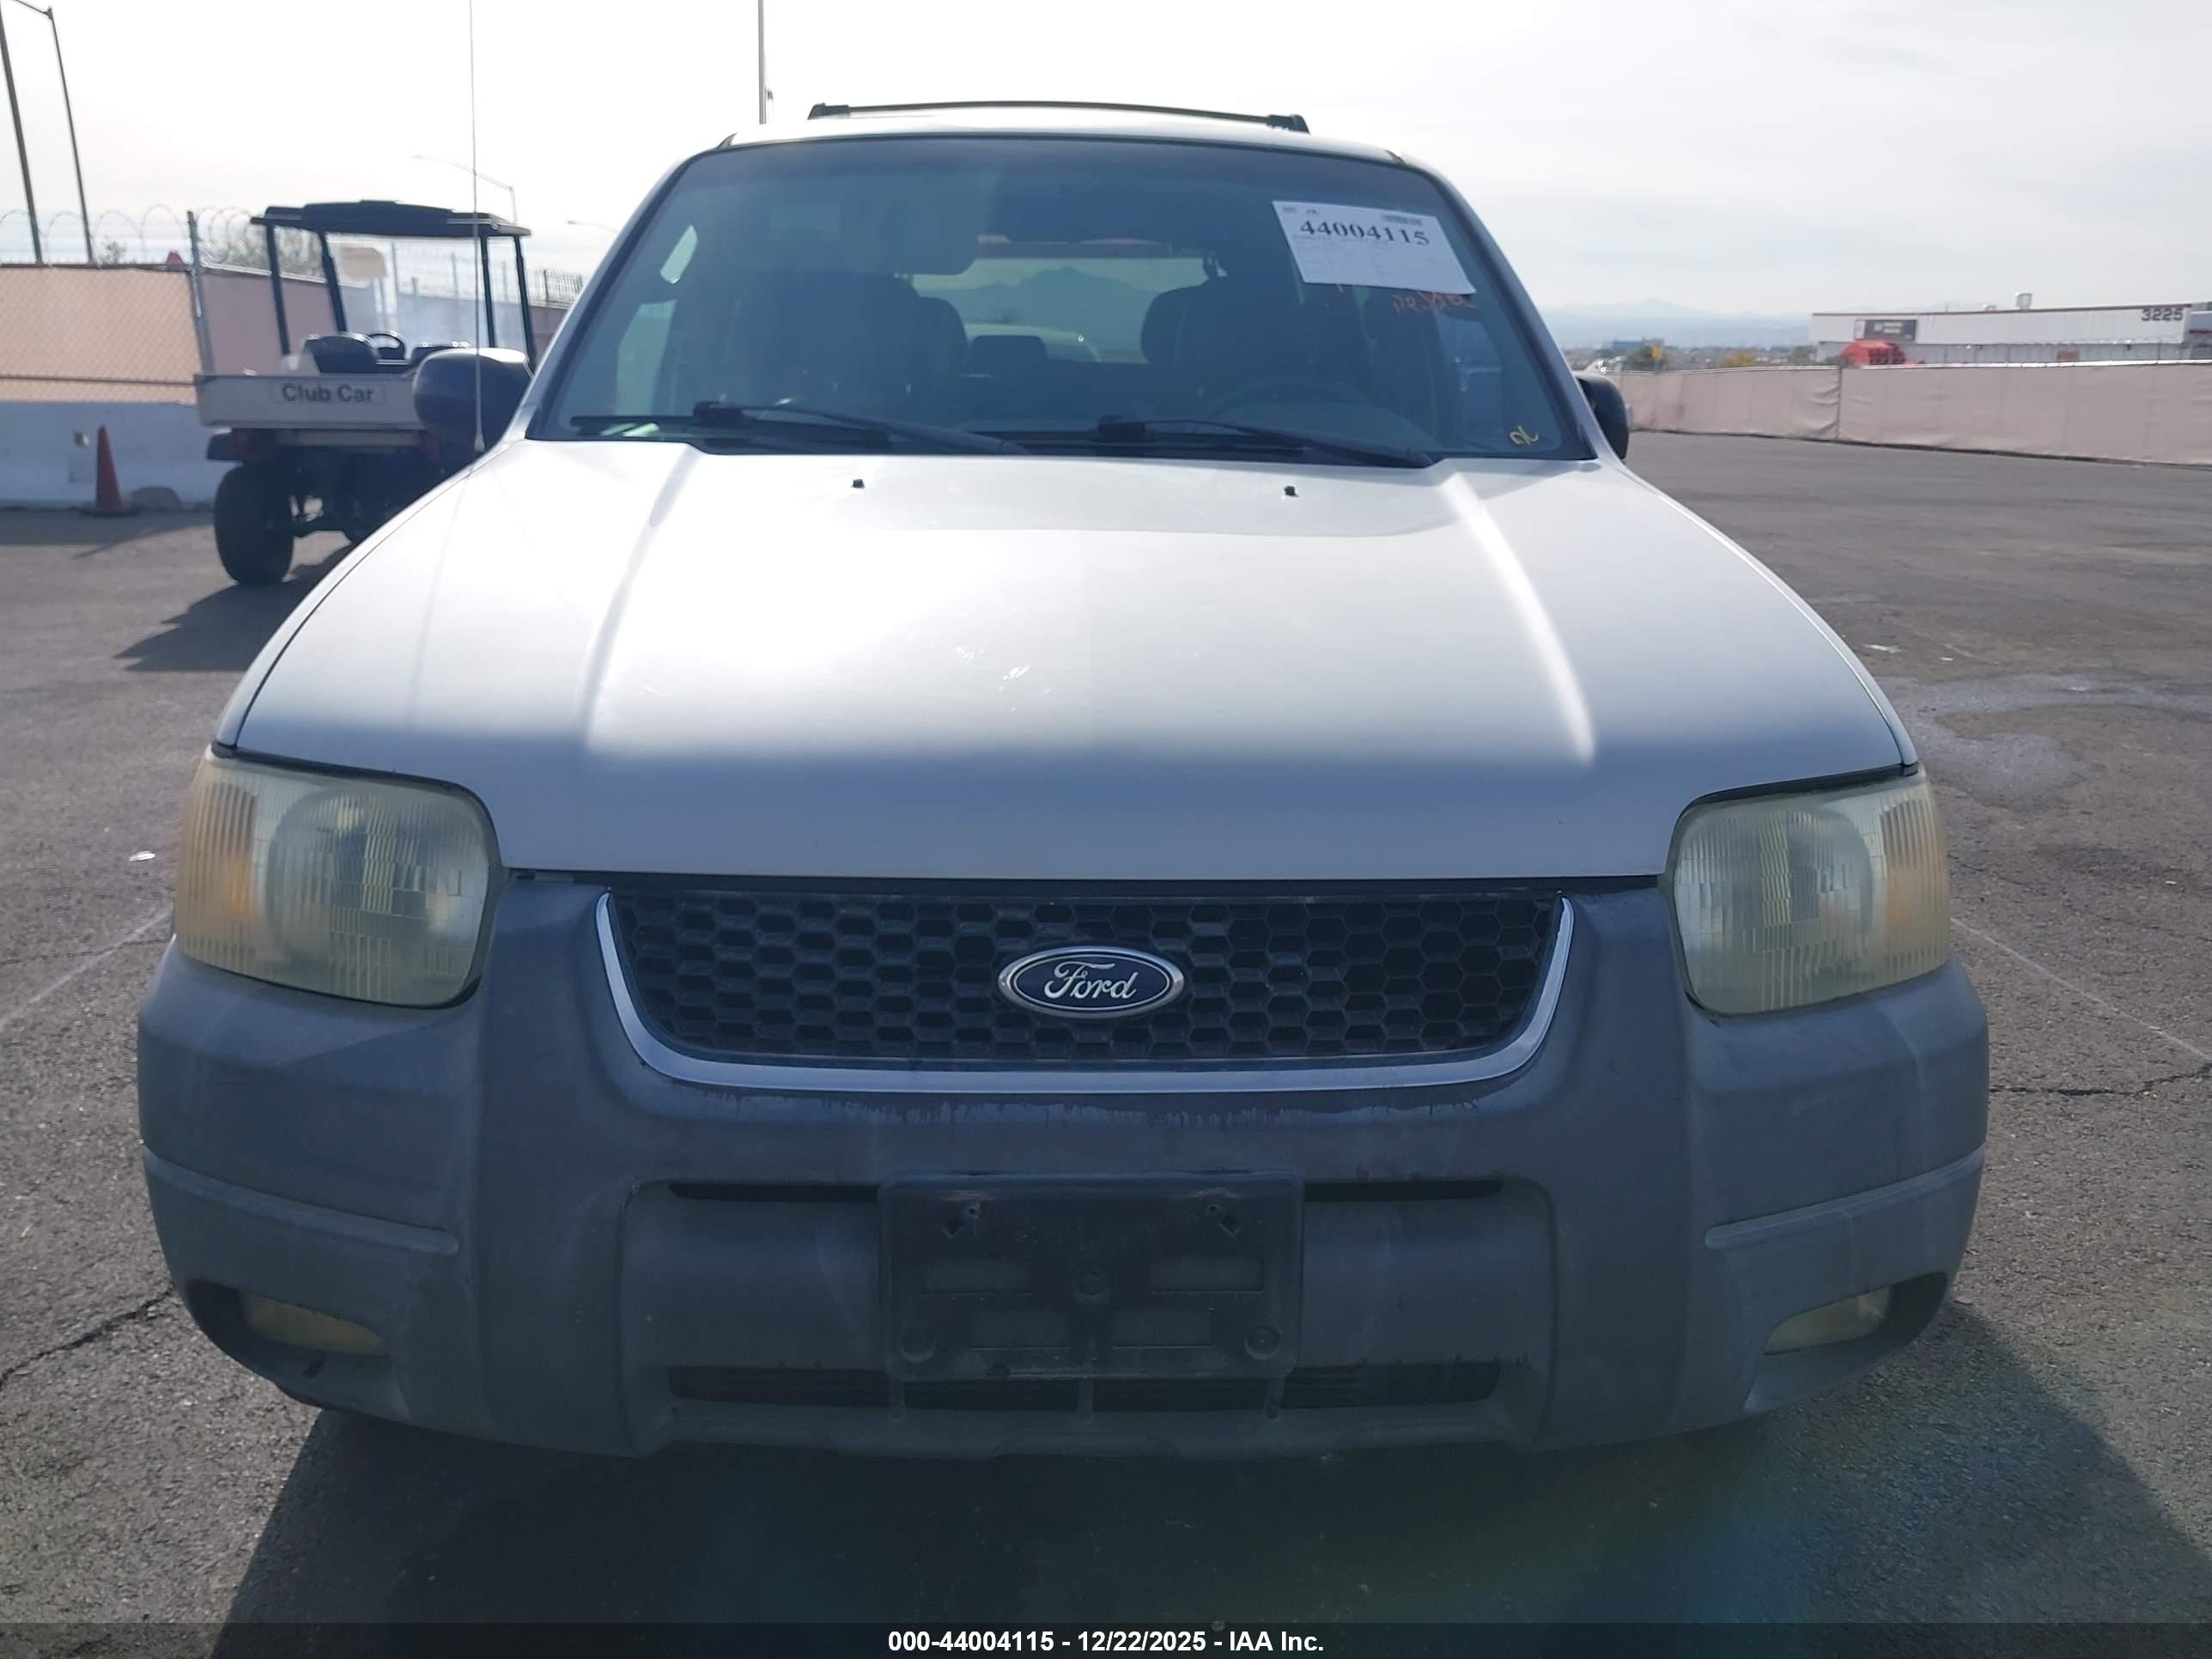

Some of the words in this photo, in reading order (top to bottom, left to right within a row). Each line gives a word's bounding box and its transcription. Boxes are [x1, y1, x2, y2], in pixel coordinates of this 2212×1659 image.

[1300, 220, 1430, 246] 44004115
[2141, 308, 2184, 322] 3225
[281, 383, 332, 402] Club
[337, 384, 374, 402] Car
[1043, 961, 1139, 999] Ford
